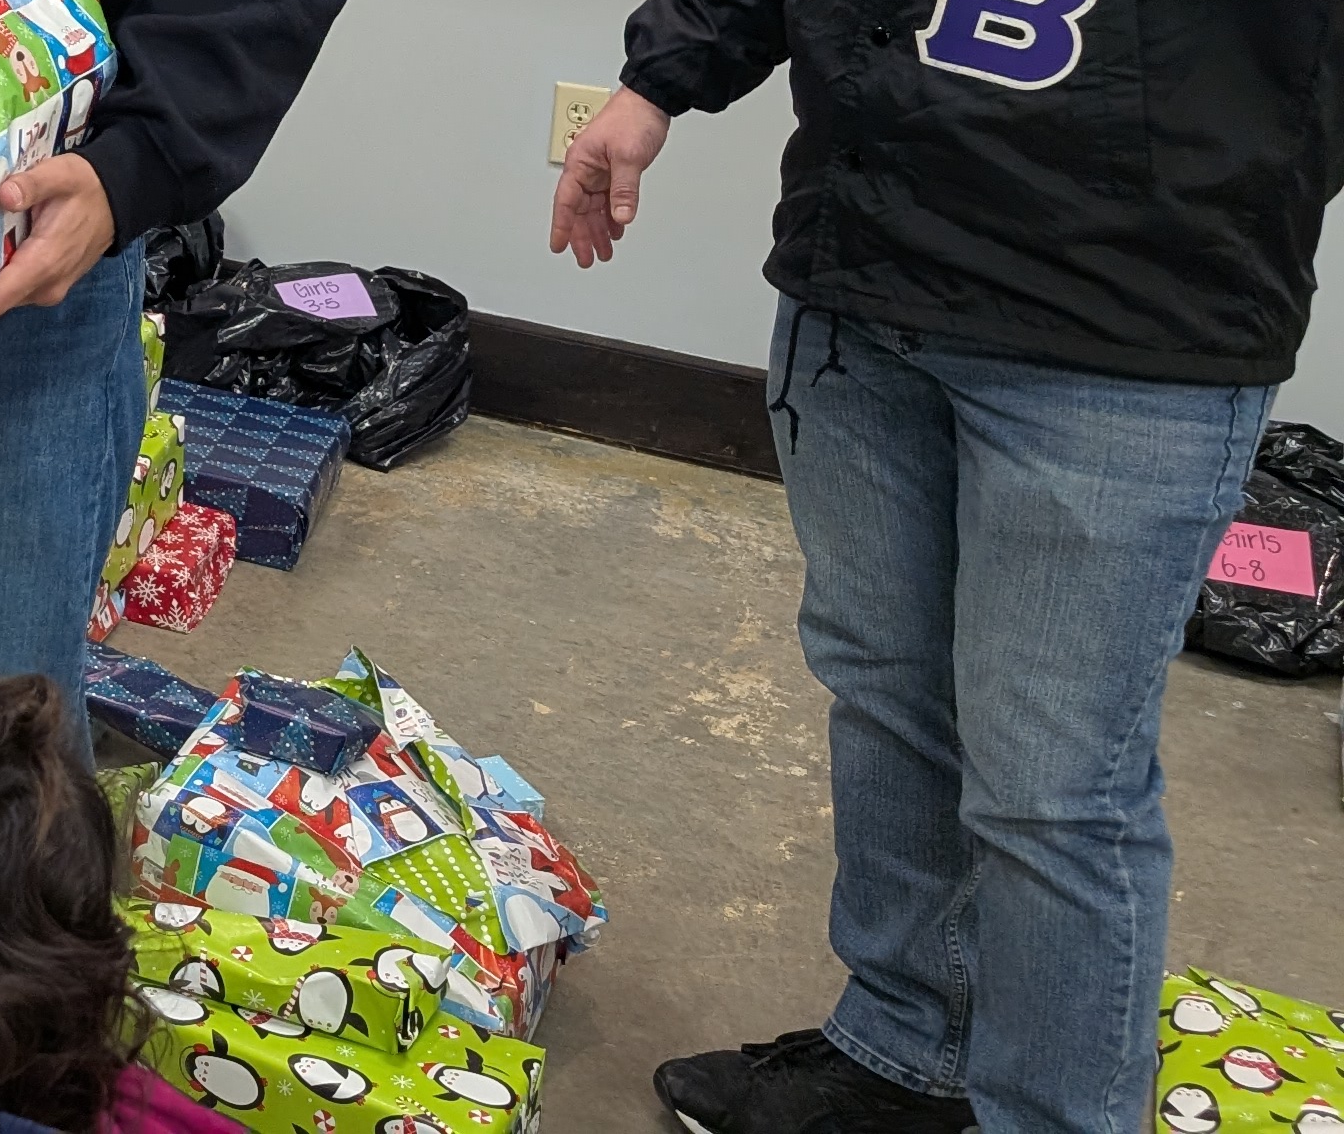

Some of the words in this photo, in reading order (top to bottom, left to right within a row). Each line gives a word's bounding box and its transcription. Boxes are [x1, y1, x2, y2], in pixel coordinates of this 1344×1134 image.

[293, 281, 340, 298] Girls
[303, 297, 341, 313] 3-5
[1221, 553, 1266, 581] 6-8
